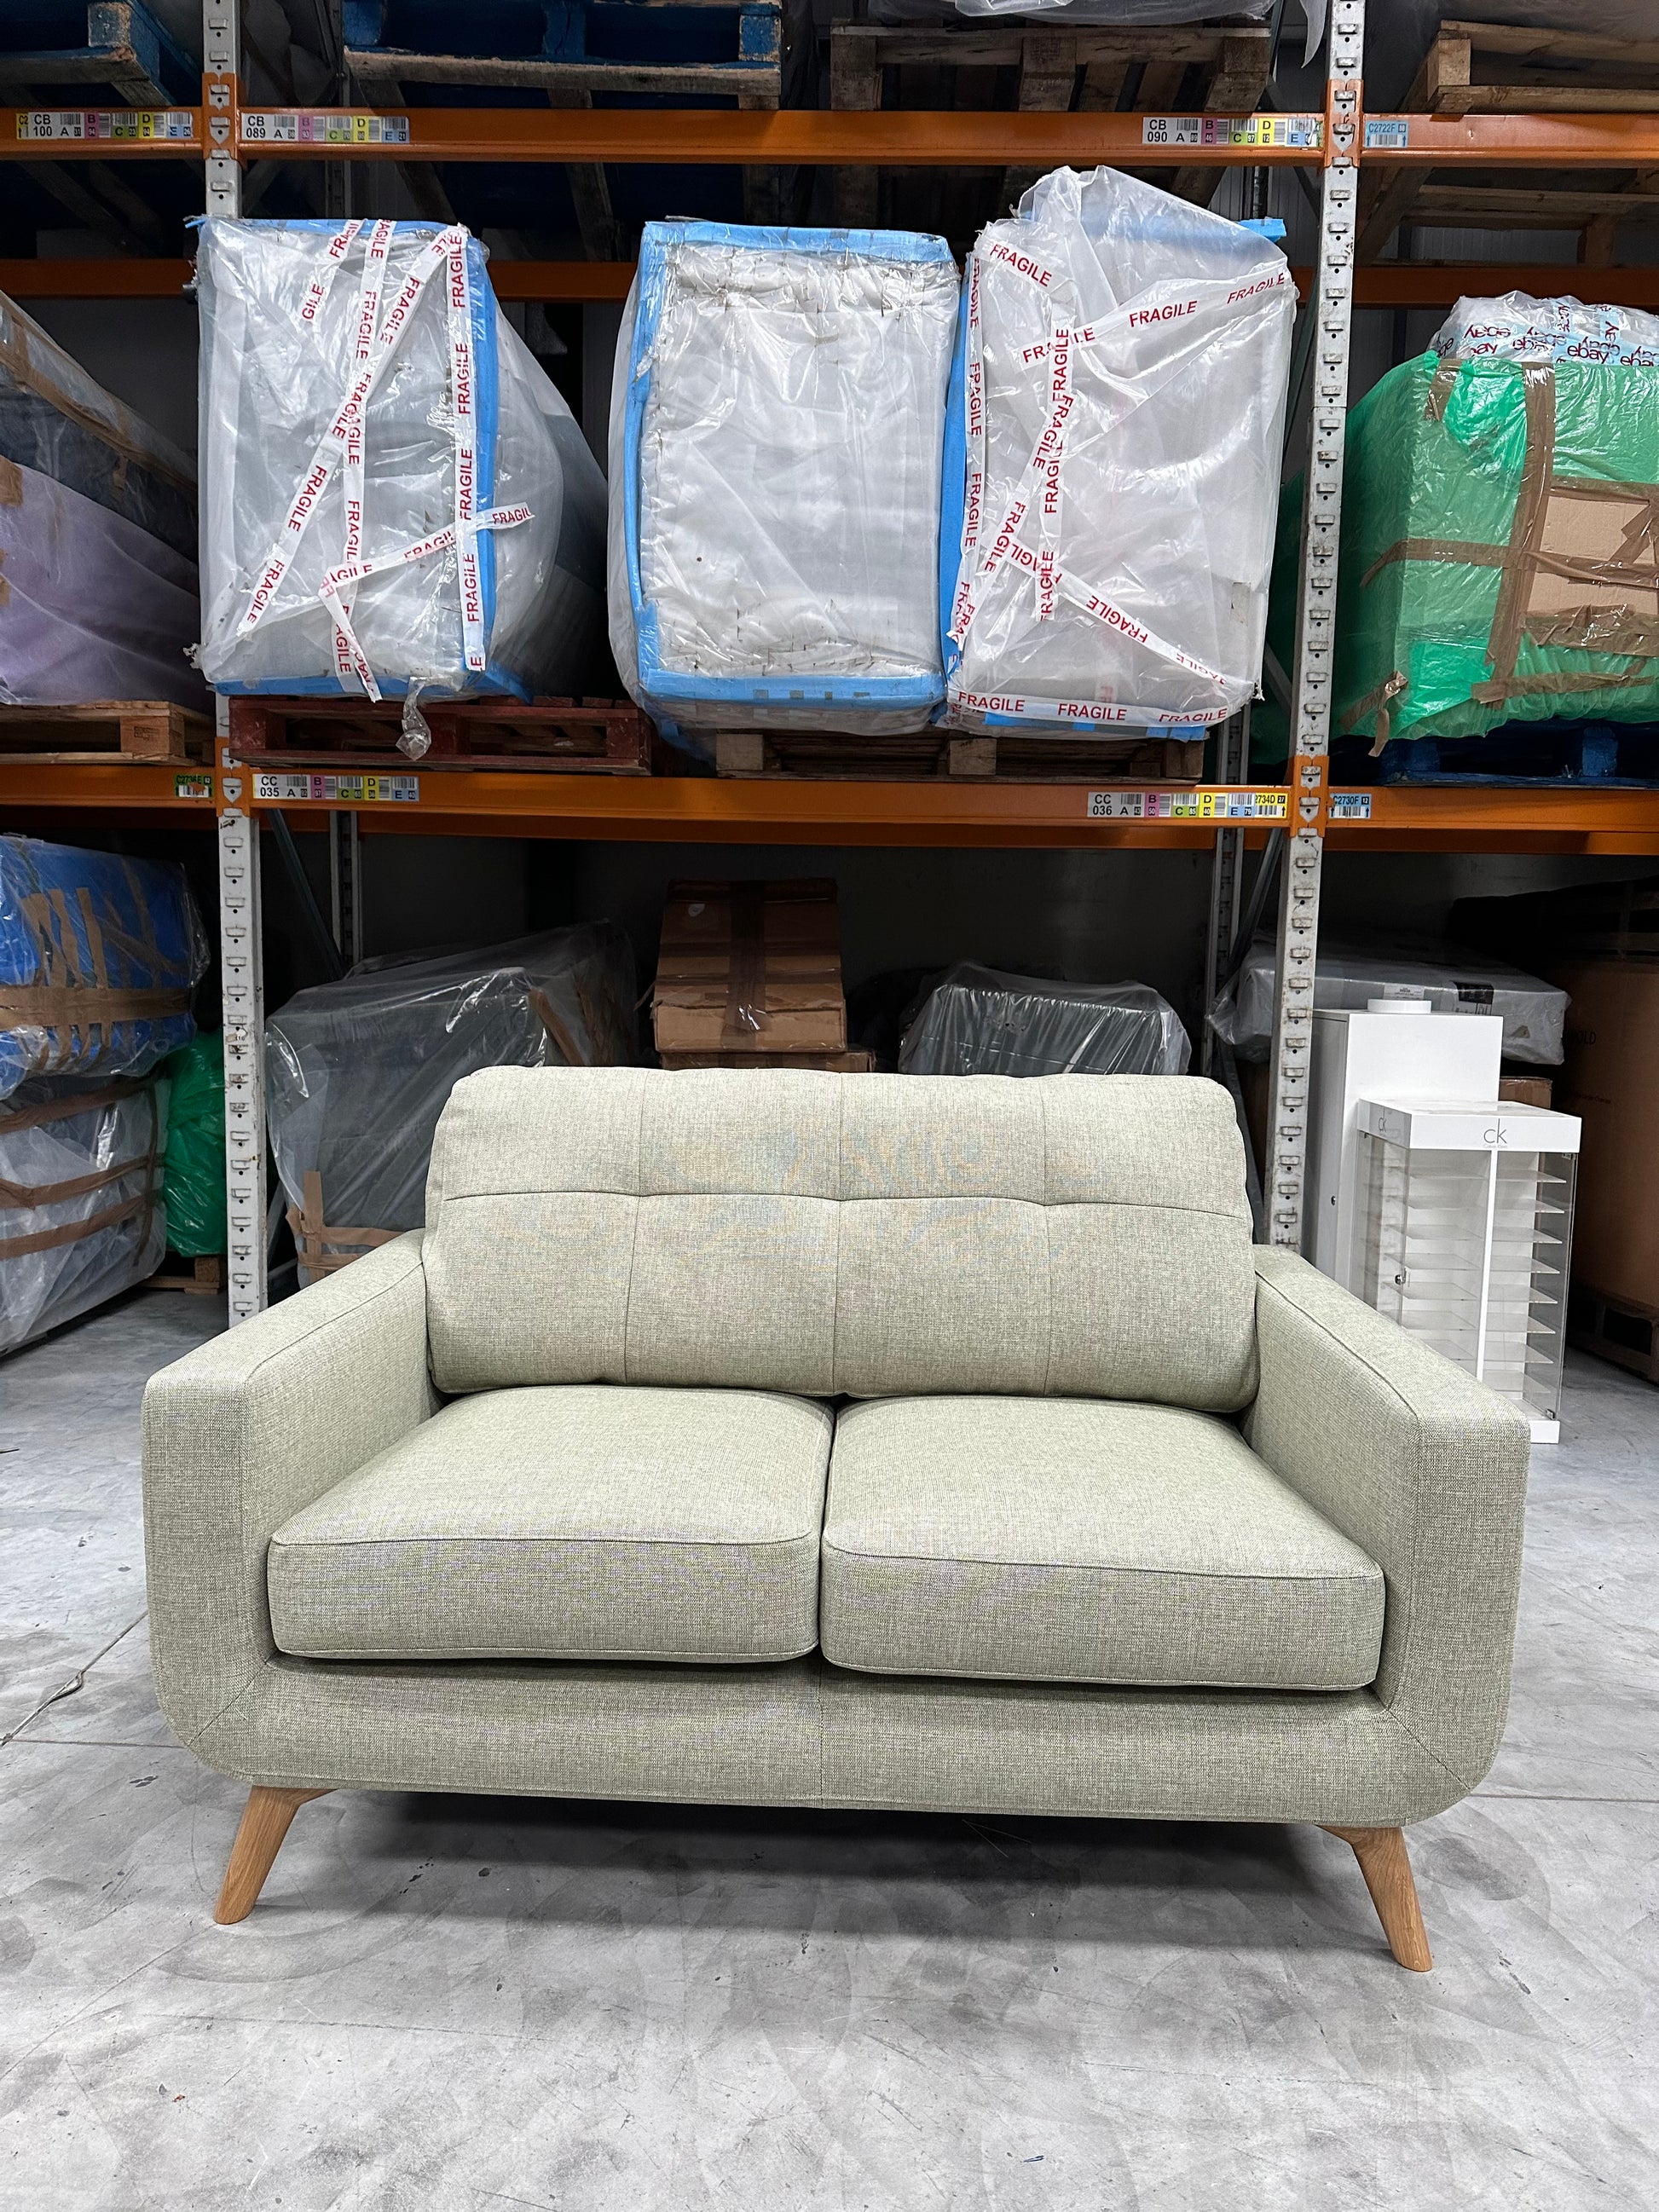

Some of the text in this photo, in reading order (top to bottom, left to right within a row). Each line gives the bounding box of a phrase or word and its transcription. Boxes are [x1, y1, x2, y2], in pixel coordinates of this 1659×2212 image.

[34, 114, 51, 124] CB
[88, 114, 95, 123] B
[143, 114, 150, 123] D
[247, 116, 264, 126] CB
[302, 118, 309, 126] B
[357, 118, 366, 128] D
[1149, 119, 1166, 130] CB
[1205, 120, 1214, 130] B
[1263, 121, 1270, 130] D
[1369, 123, 1396, 133] C2722F
[33, 126, 52, 136] 100
[61, 127, 69, 136] A
[115, 127, 123, 136] C
[246, 128, 266, 138] 089
[274, 130, 283, 138] A
[329, 130, 338, 140] C
[385, 131, 393, 140] E
[1147, 131, 1167, 141] 090
[1176, 133, 1185, 141] A
[1233, 133, 1241, 143] C
[1291, 133, 1298, 143] E
[990, 244, 1052, 287] FRAGILE
[450, 235, 465, 308] FRAGILE
[1227, 272, 1285, 304] FRAGILE
[380, 277, 420, 345] FRAGILE
[1129, 300, 1198, 328] FRAGILE
[356, 291, 377, 360] FRAGILE
[1567, 343, 1610, 364] ebay
[1052, 329, 1068, 401] FRAGILE
[454, 343, 471, 414] FRAGILE
[460, 448, 472, 521] FRAGILE
[288, 465, 327, 532] FRAGILE
[964, 473, 981, 547] FRAGILE
[346, 500, 360, 564] FRAGIL
[984, 501, 1026, 573] FRAGILE
[246, 558, 285, 624] FRAGILE
[462, 553, 480, 622] FRAGILE
[1086, 595, 1148, 644] FRAGILE
[959, 691, 1228, 722] FRAGILE FRAGILE FRAGILE
[261, 776, 277, 786] CC
[368, 777, 375, 786] D
[260, 788, 280, 797] 035
[287, 788, 295, 797] A
[341, 789, 349, 798] C
[396, 790, 402, 800] E
[1095, 794, 1111, 805] CC
[1148, 794, 1156, 803] B
[1093, 806, 1112, 815] 036
[1120, 806, 1129, 815] A
[1175, 806, 1183, 815] C
[1231, 807, 1238, 816] E
[1483, 1118, 1507, 1144] ck
